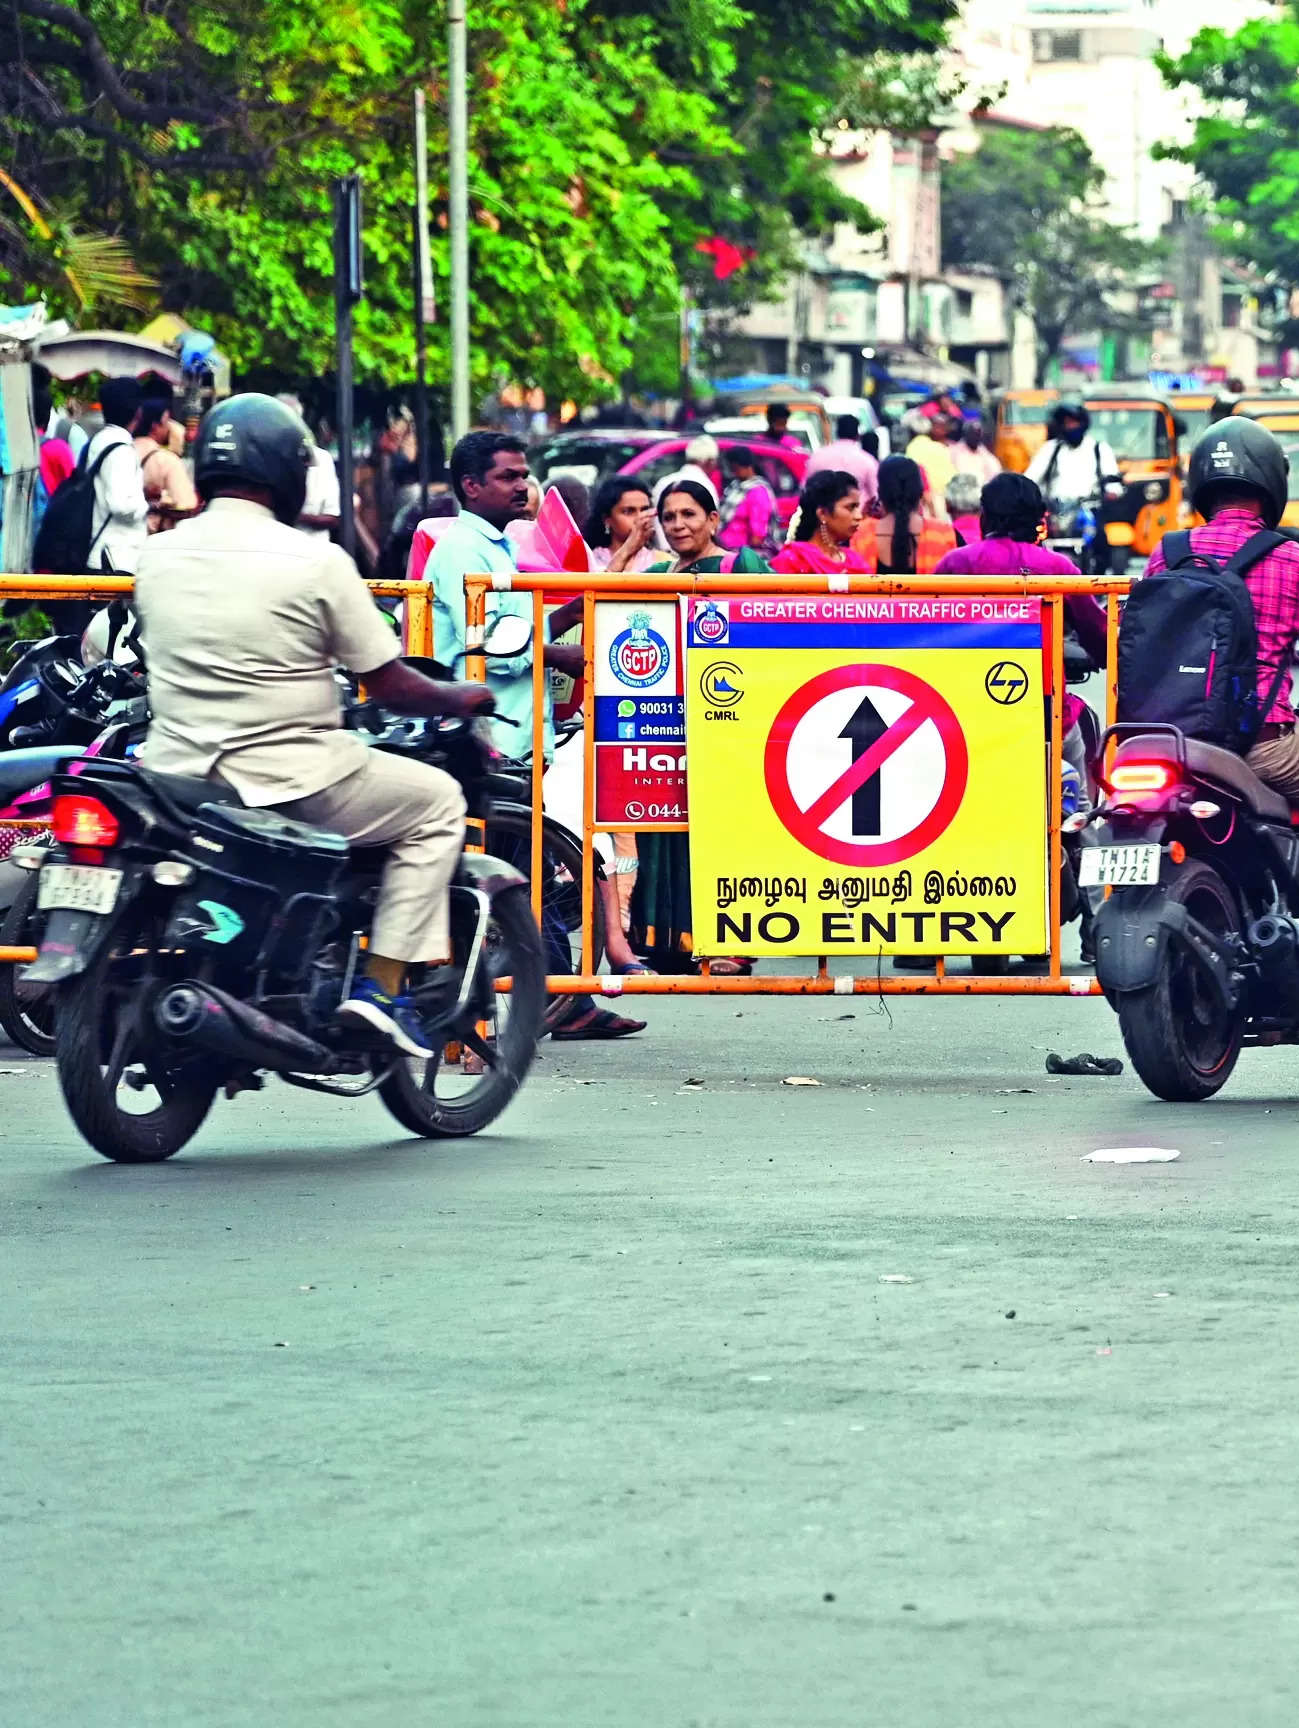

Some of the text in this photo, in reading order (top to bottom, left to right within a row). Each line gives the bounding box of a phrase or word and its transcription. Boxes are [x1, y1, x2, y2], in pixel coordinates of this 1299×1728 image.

[741, 602, 1030, 619] GREATER CHENNAI TRAFFIC POLICE
[703, 623, 719, 633] GCTP
[622, 648, 657, 671] GCTP
[639, 702, 673, 714] 90031
[705, 711, 740, 721] CMRL
[717, 870, 1017, 909] நுழைவு அனுமதி இல்லை
[716, 911, 1017, 943] NO ENTRY
